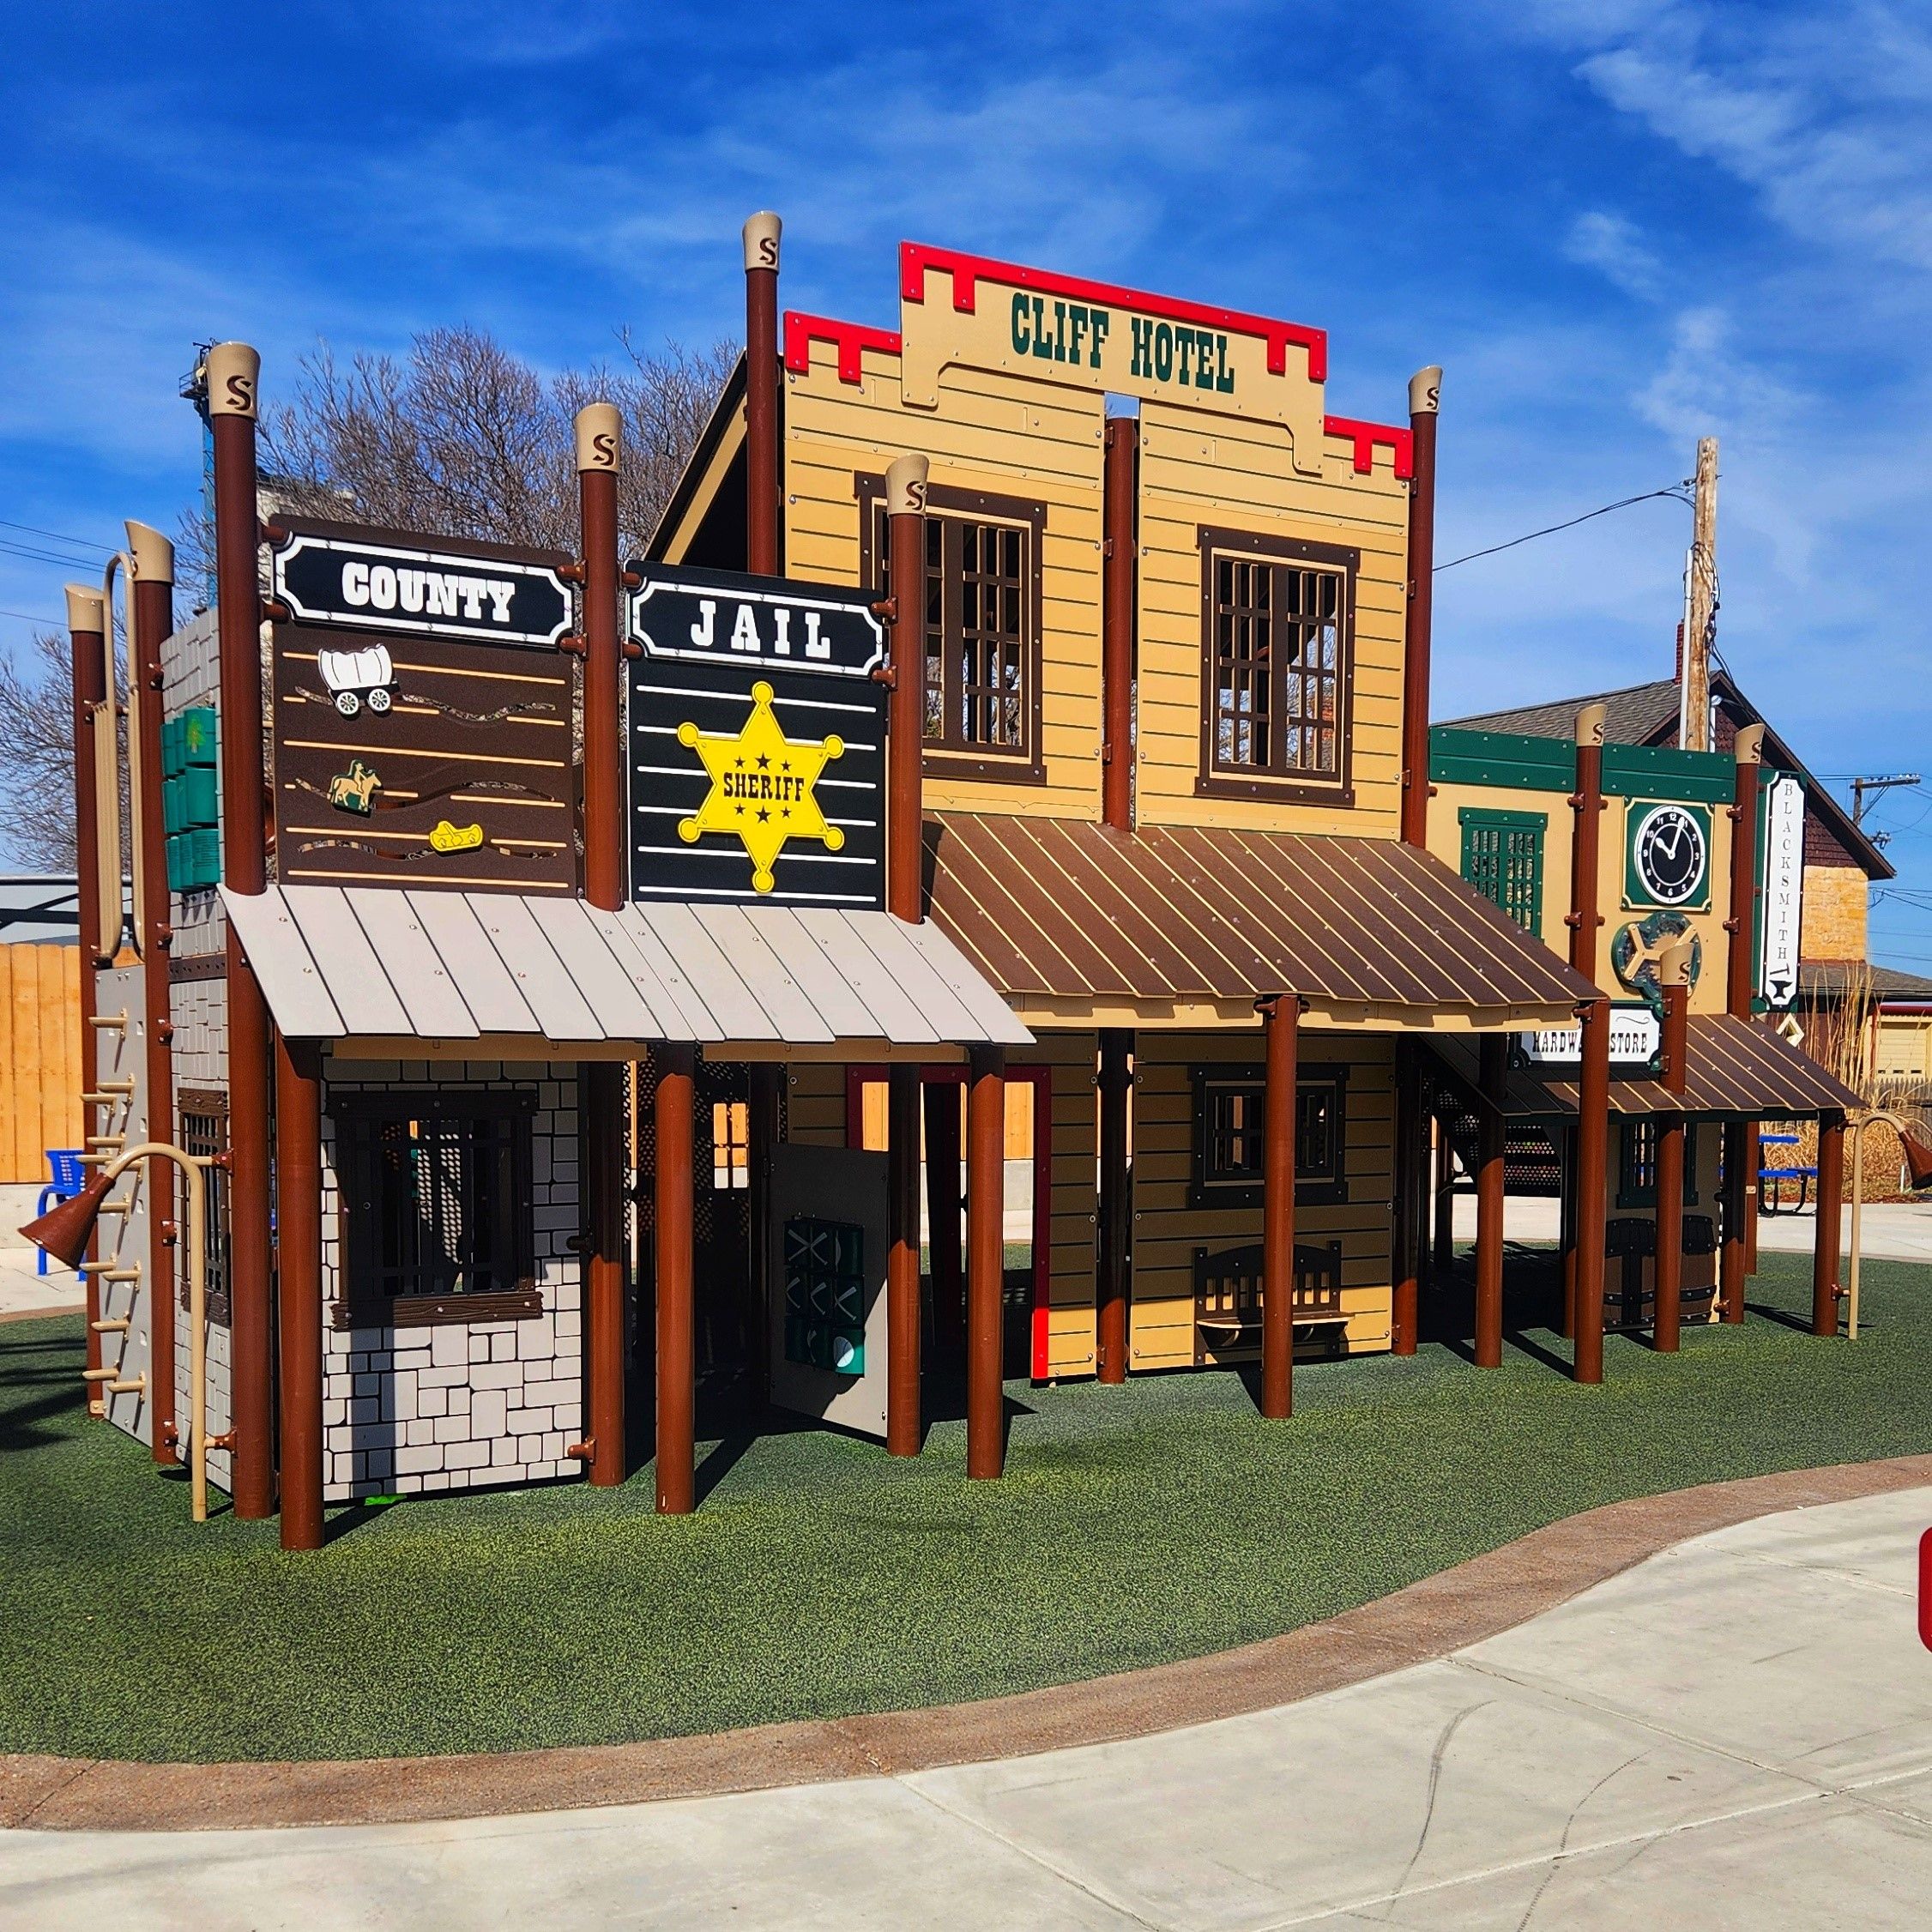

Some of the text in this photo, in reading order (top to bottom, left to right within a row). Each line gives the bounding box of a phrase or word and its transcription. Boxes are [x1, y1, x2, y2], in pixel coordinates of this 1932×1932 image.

[759, 237, 777, 265] S
[1011, 292, 1235, 395] CLIFF HOTEL
[226, 375, 254, 411] S
[592, 433, 617, 466] S
[905, 480, 926, 511] S
[341, 561, 516, 622] COUNTY
[691, 600, 830, 659] JAIL
[723, 771, 805, 802] SHERIFF
[1669, 812, 1677, 821] 12
[1777, 783, 1793, 960] BLACKSMITH
[1532, 1031, 1648, 1054] HARDW STORE
